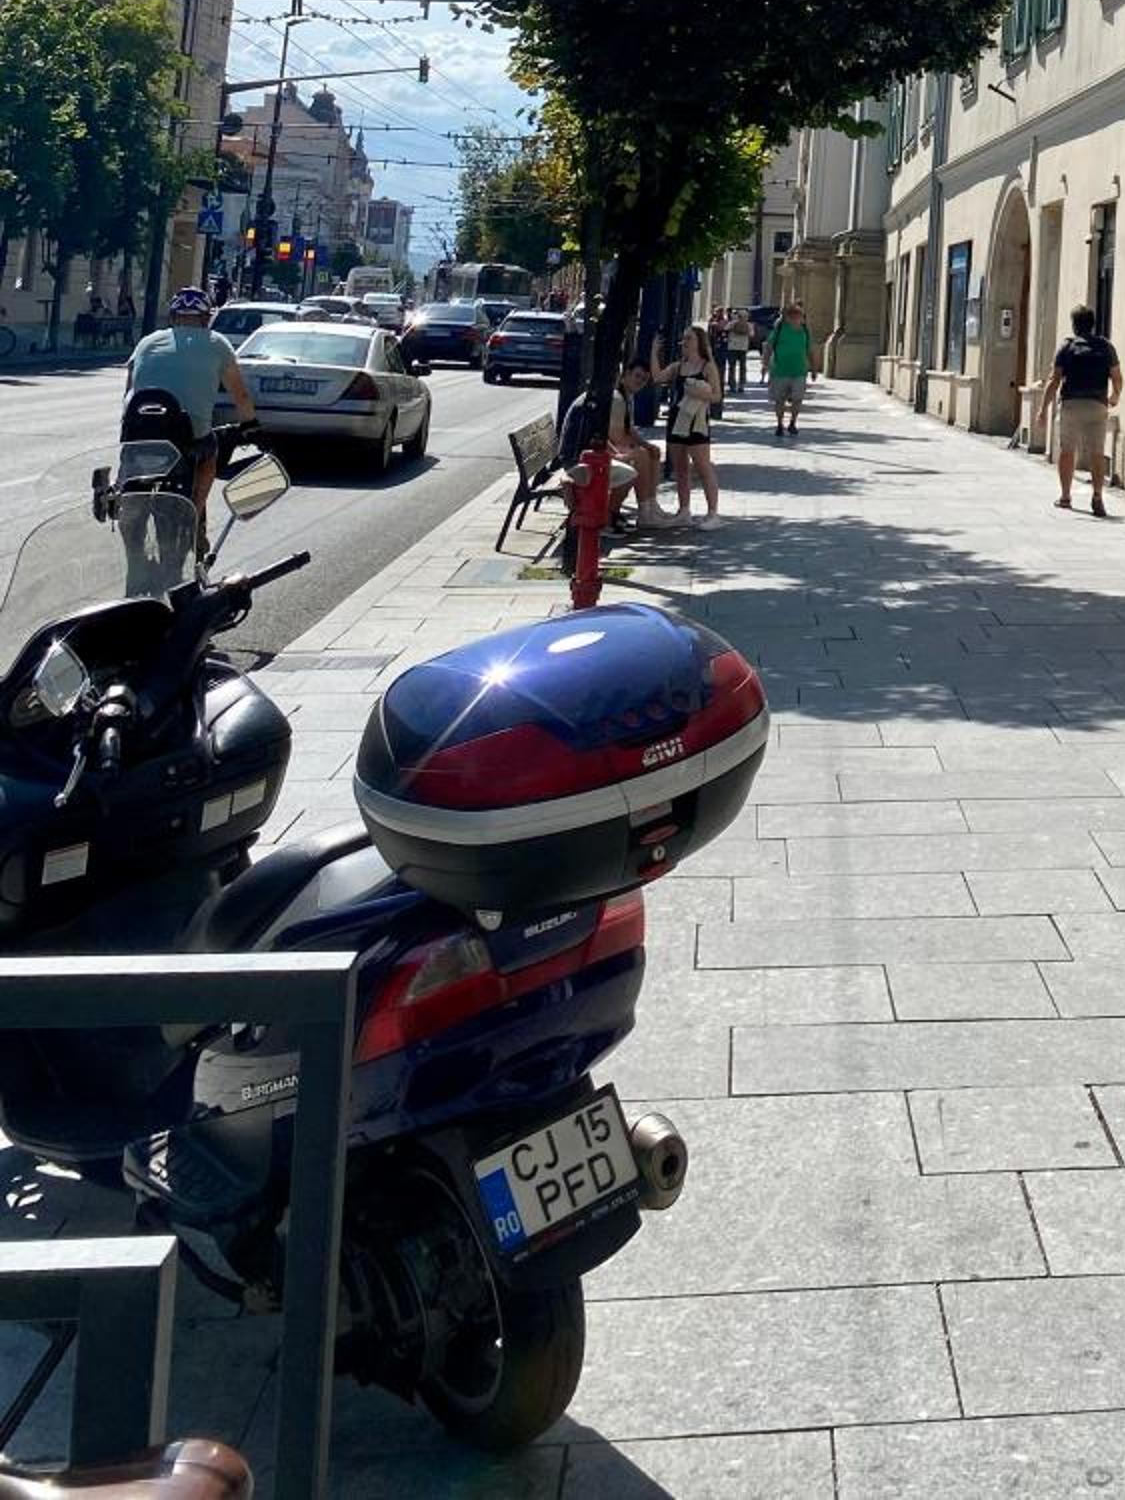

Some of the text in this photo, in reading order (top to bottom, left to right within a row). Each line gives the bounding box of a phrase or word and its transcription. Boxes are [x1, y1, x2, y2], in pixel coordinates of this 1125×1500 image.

[642, 736, 684, 767] GIVI
[524, 911, 577, 939] SUZUKI
[511, 1104, 611, 1181] CJ 15
[535, 1152, 616, 1222] PFD
[494, 1211, 520, 1242] RO
